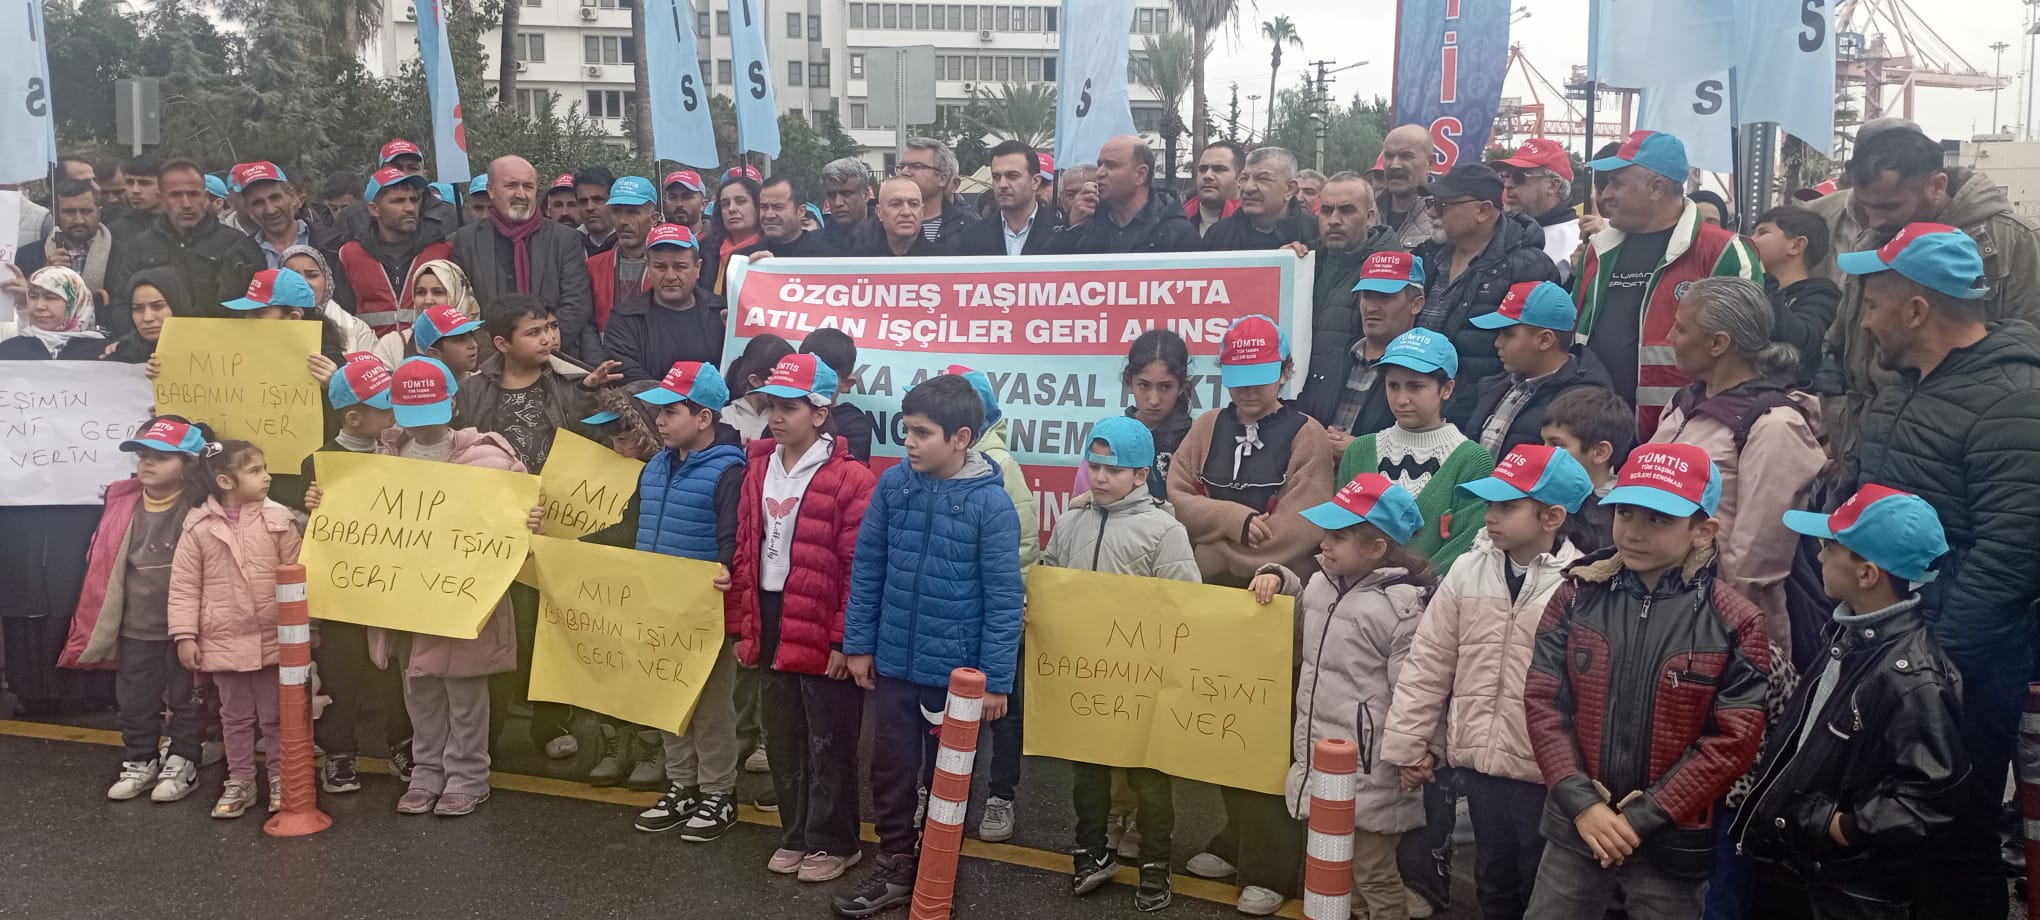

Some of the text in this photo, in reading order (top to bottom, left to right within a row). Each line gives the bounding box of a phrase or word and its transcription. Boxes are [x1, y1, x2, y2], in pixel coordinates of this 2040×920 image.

[1692, 79, 1724, 115] S
[779, 278, 1231, 314] ÖZGÜNEŞ TAŞIMACILIK'TA
[878, 314, 1013, 348] İŞÇİLER
[1025, 312, 1109, 344] GERİ
[189, 351, 244, 378] MIP
[156, 382, 244, 406] BABAMIN
[244, 413, 298, 440] VER
[10, 445, 98, 468] VERİN
[1637, 452, 1689, 473] TÜMTİS
[370, 486, 446, 521] MIP
[312, 514, 515, 559] BABAMIN İŞİNİ
[330, 560, 478, 603] GERİ VER
[578, 581, 631, 607] MIP
[544, 601, 711, 654] BABAMIN İŞİNİ
[1106, 619, 1190, 654] MIP
[576, 642, 689, 688] GERİ VER
[1037, 651, 1277, 705] BABAMIN İŞİNİ
[1070, 691, 1246, 751] GERİ VER
